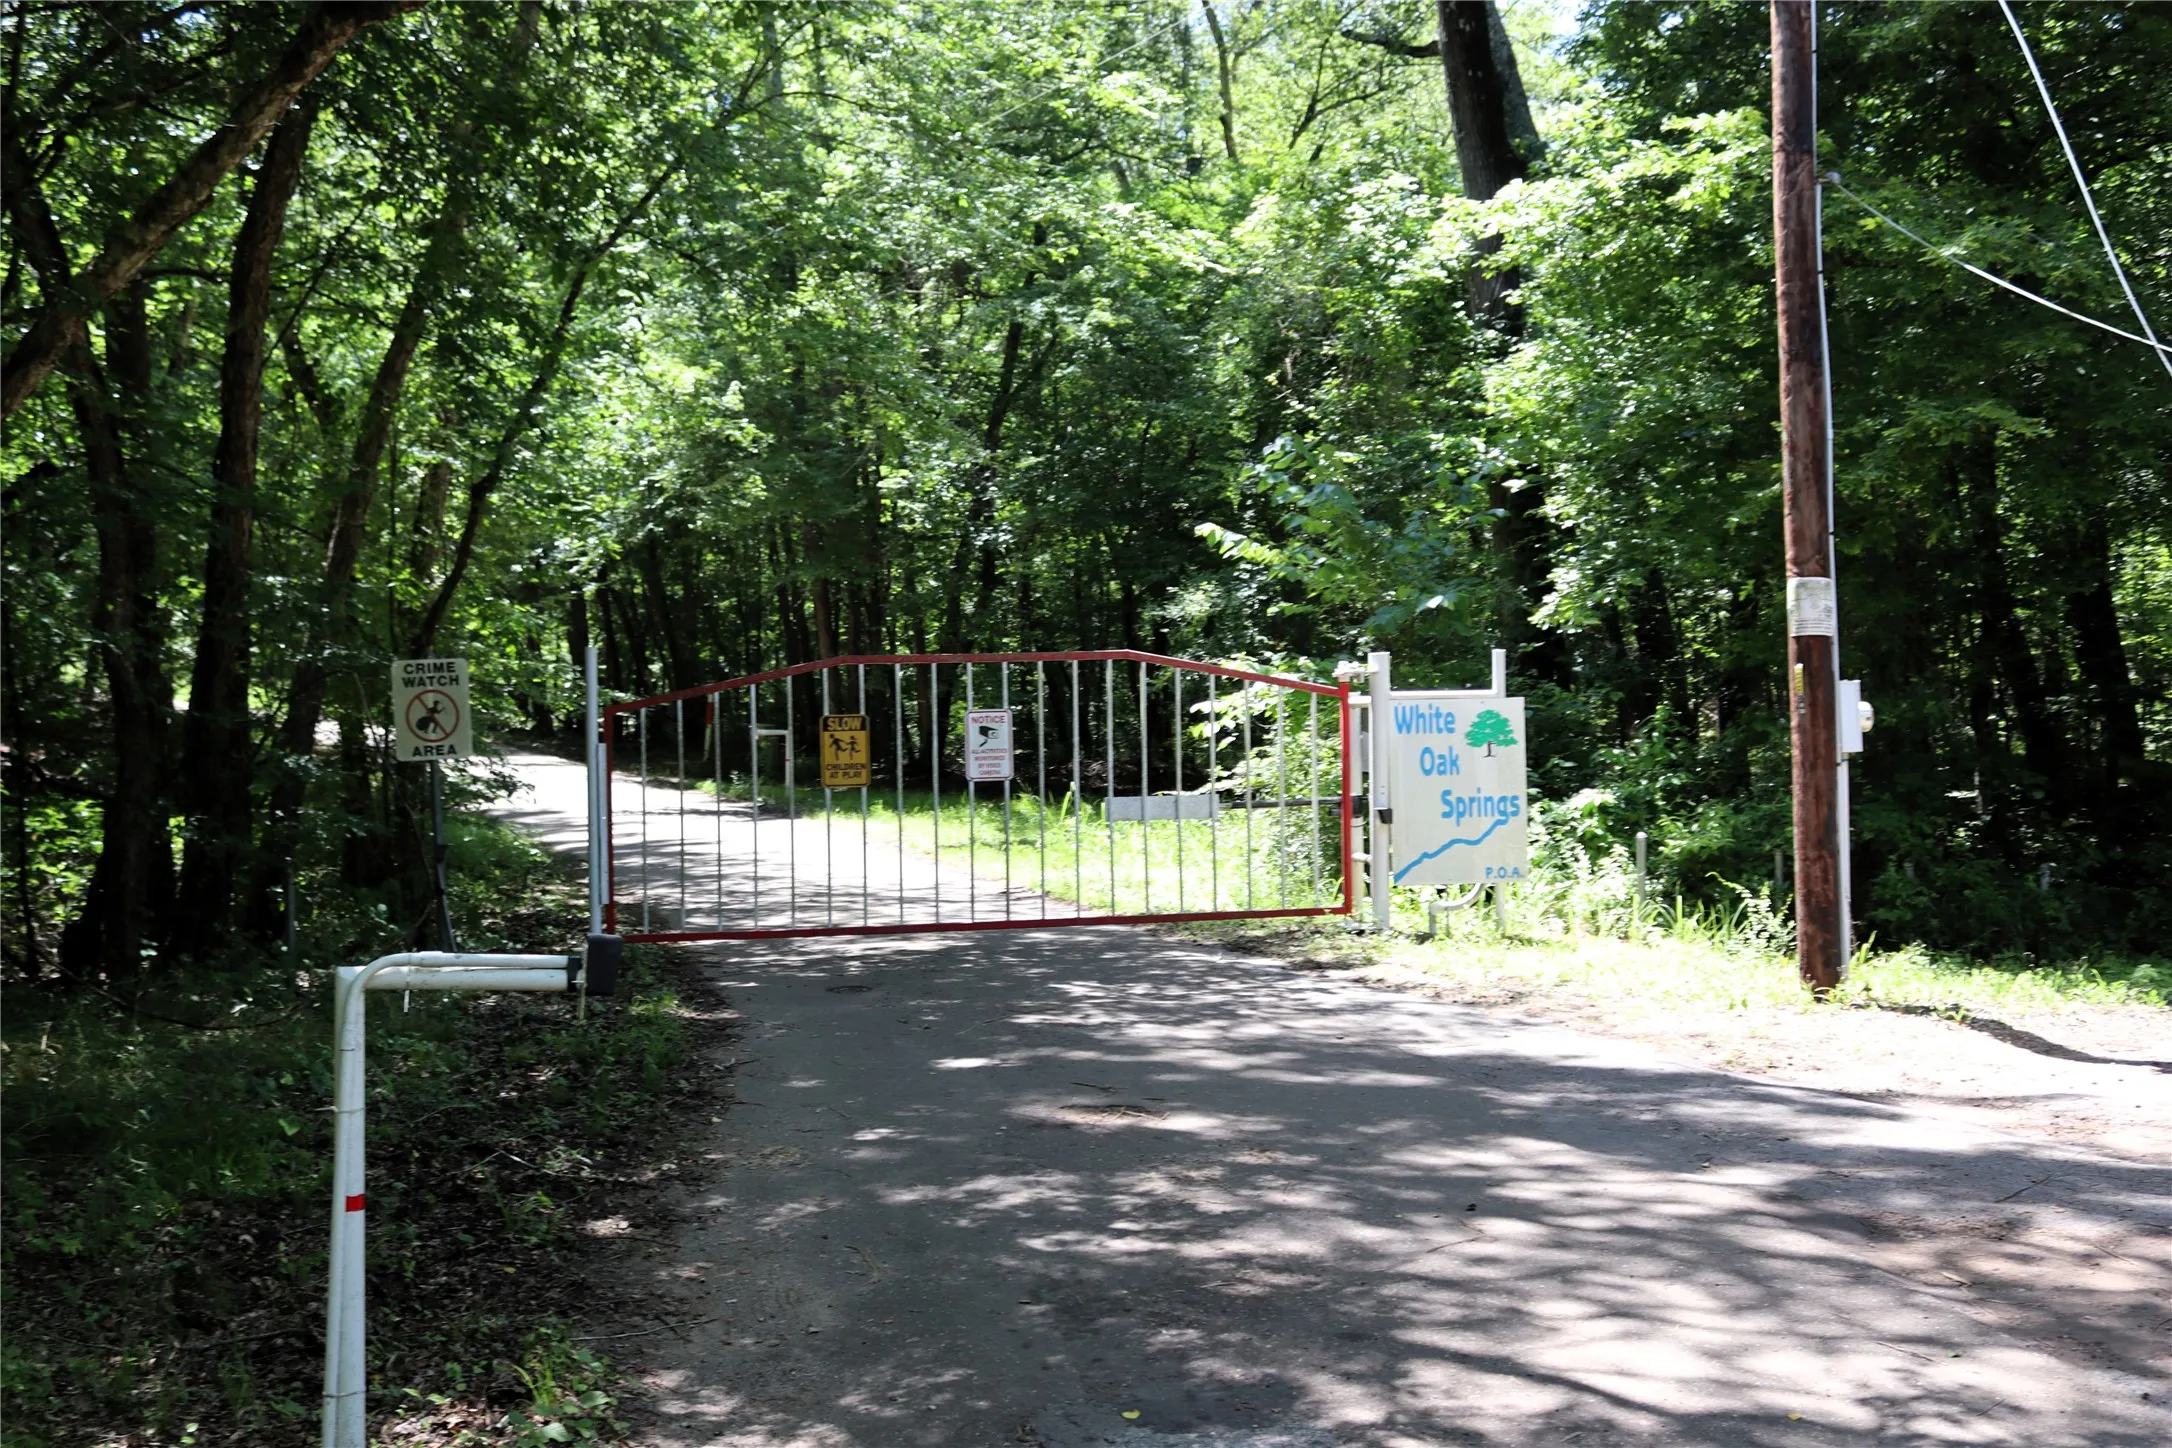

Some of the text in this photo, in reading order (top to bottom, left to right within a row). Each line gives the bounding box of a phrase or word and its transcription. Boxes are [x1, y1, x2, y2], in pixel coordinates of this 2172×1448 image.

[404, 662, 456, 674] CRIME
[402, 674, 459, 688] WATCH
[827, 717, 862, 730] SLOW
[971, 715, 1006, 724] NOTICE
[1394, 703, 1456, 734] White
[412, 745, 457, 757] AREA
[825, 763, 866, 771] CHILDREN
[1420, 745, 1460, 776] Oak
[1440, 787, 1521, 827] Springs
